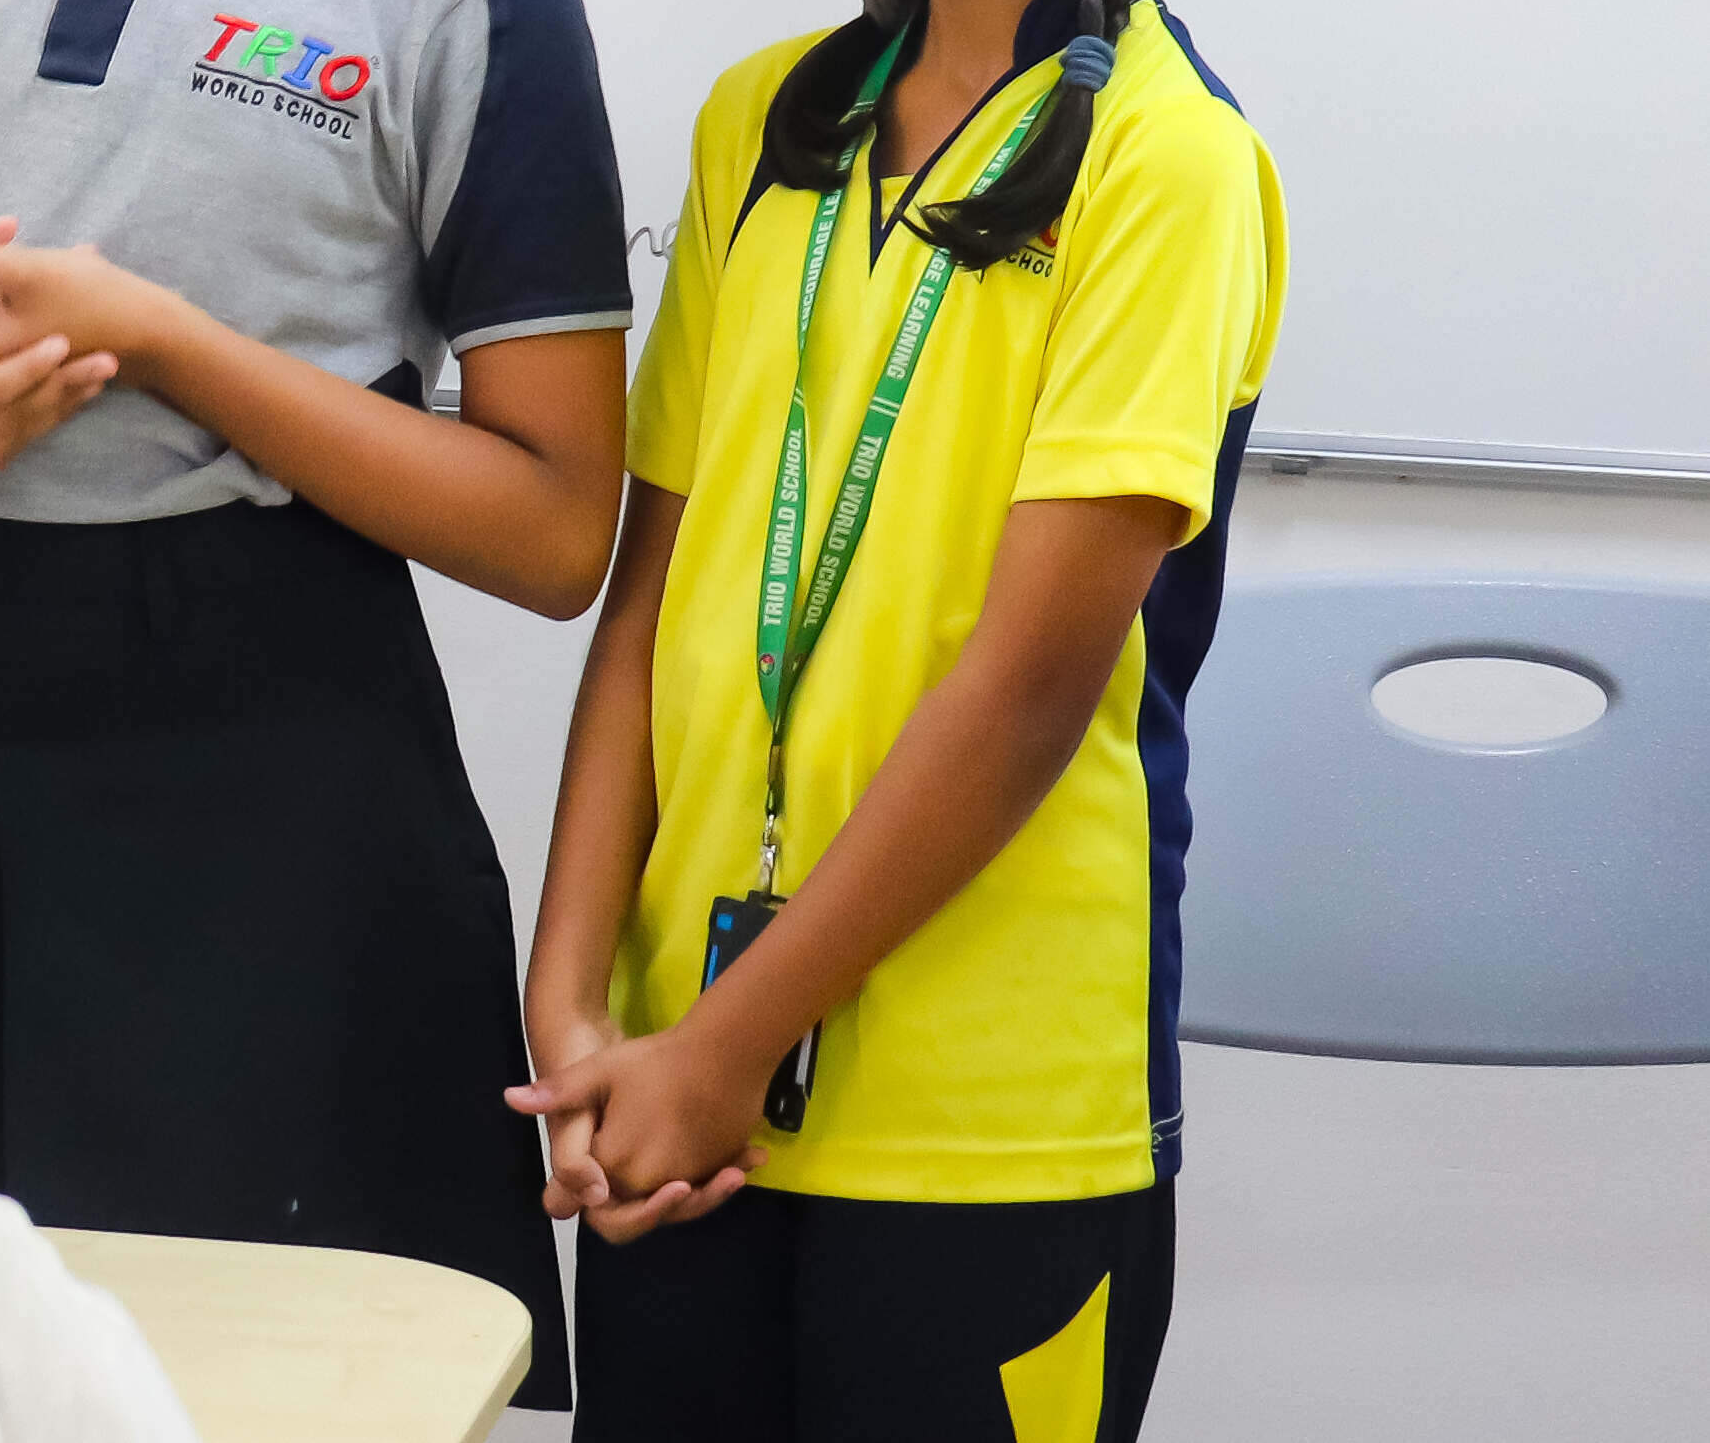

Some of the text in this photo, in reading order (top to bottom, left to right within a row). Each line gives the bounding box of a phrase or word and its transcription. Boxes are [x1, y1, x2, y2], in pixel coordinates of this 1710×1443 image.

[204, 12, 371, 102] TRIO
[191, 71, 352, 140] WORLD SCHOOL
[1004, 251, 1053, 278] CHOO
[886, 284, 936, 381] LEARNING
[763, 428, 803, 627] TRIO WORLD SCHOOL
[803, 434, 884, 629] TRIO WORLD SCHOOL
